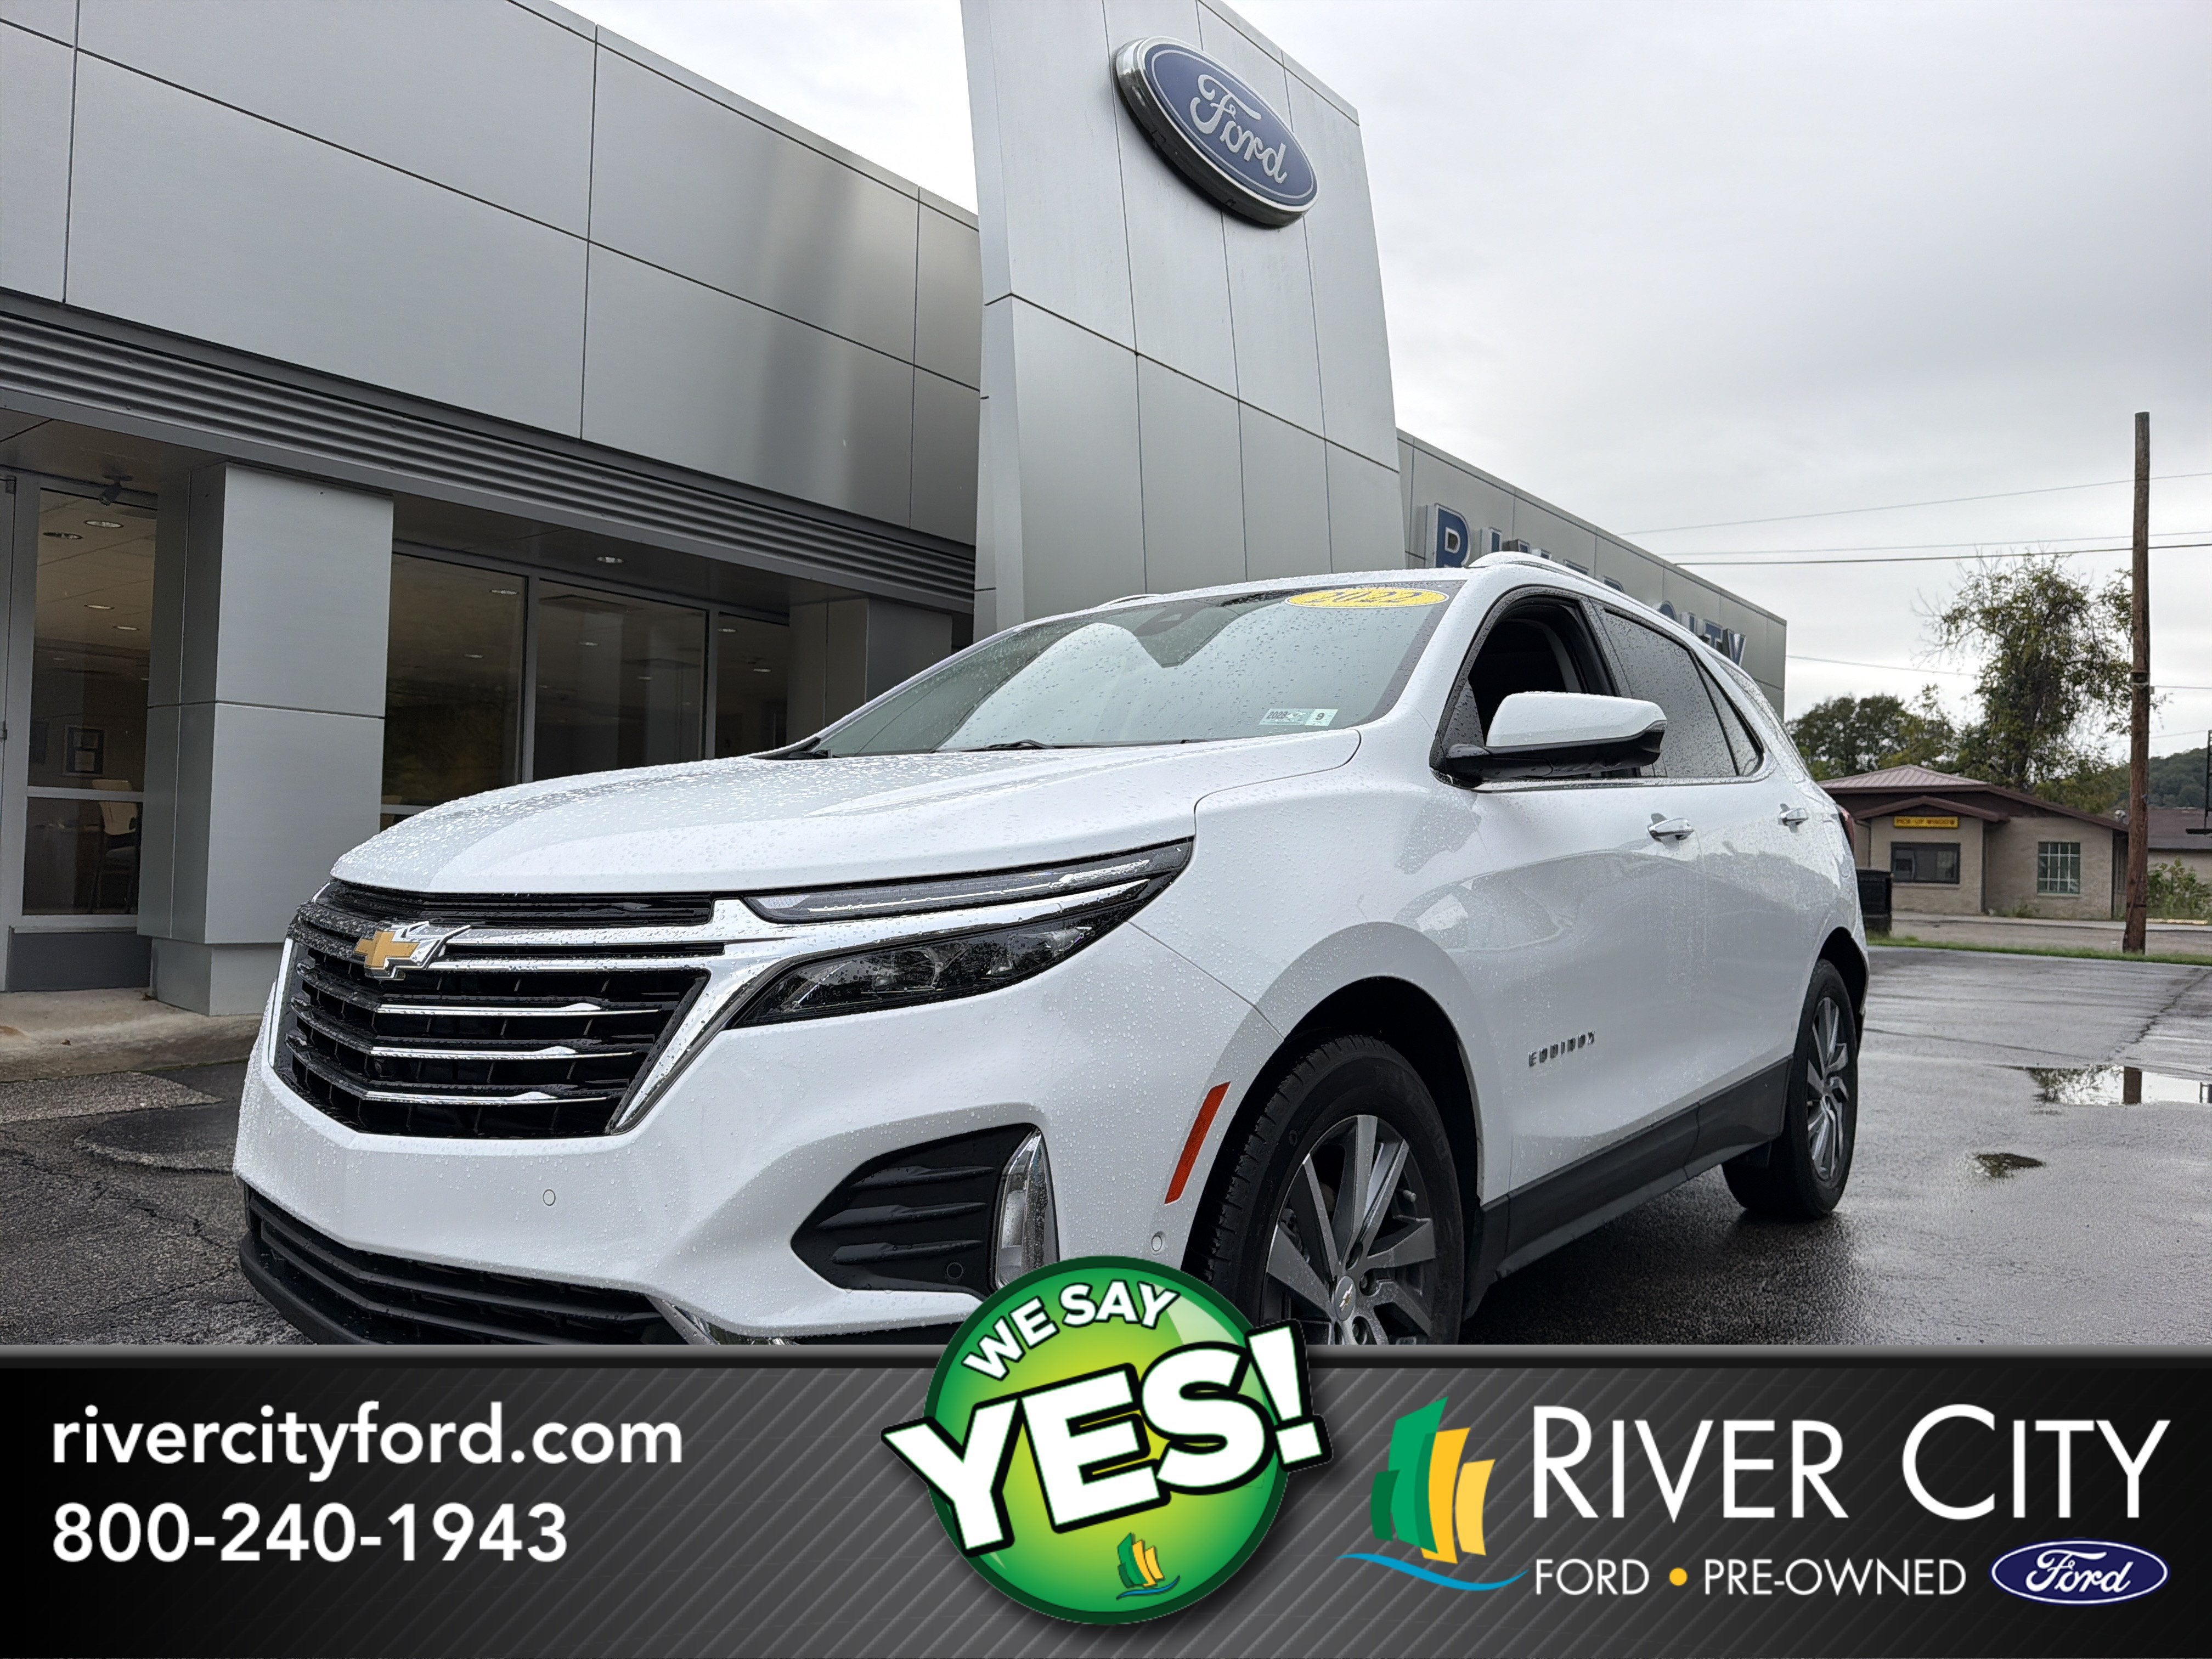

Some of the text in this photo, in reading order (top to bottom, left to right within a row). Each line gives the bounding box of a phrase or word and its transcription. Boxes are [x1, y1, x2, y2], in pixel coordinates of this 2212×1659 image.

[1189, 74, 1288, 184] Ford
[1266, 710, 1325, 720] 2028 9
